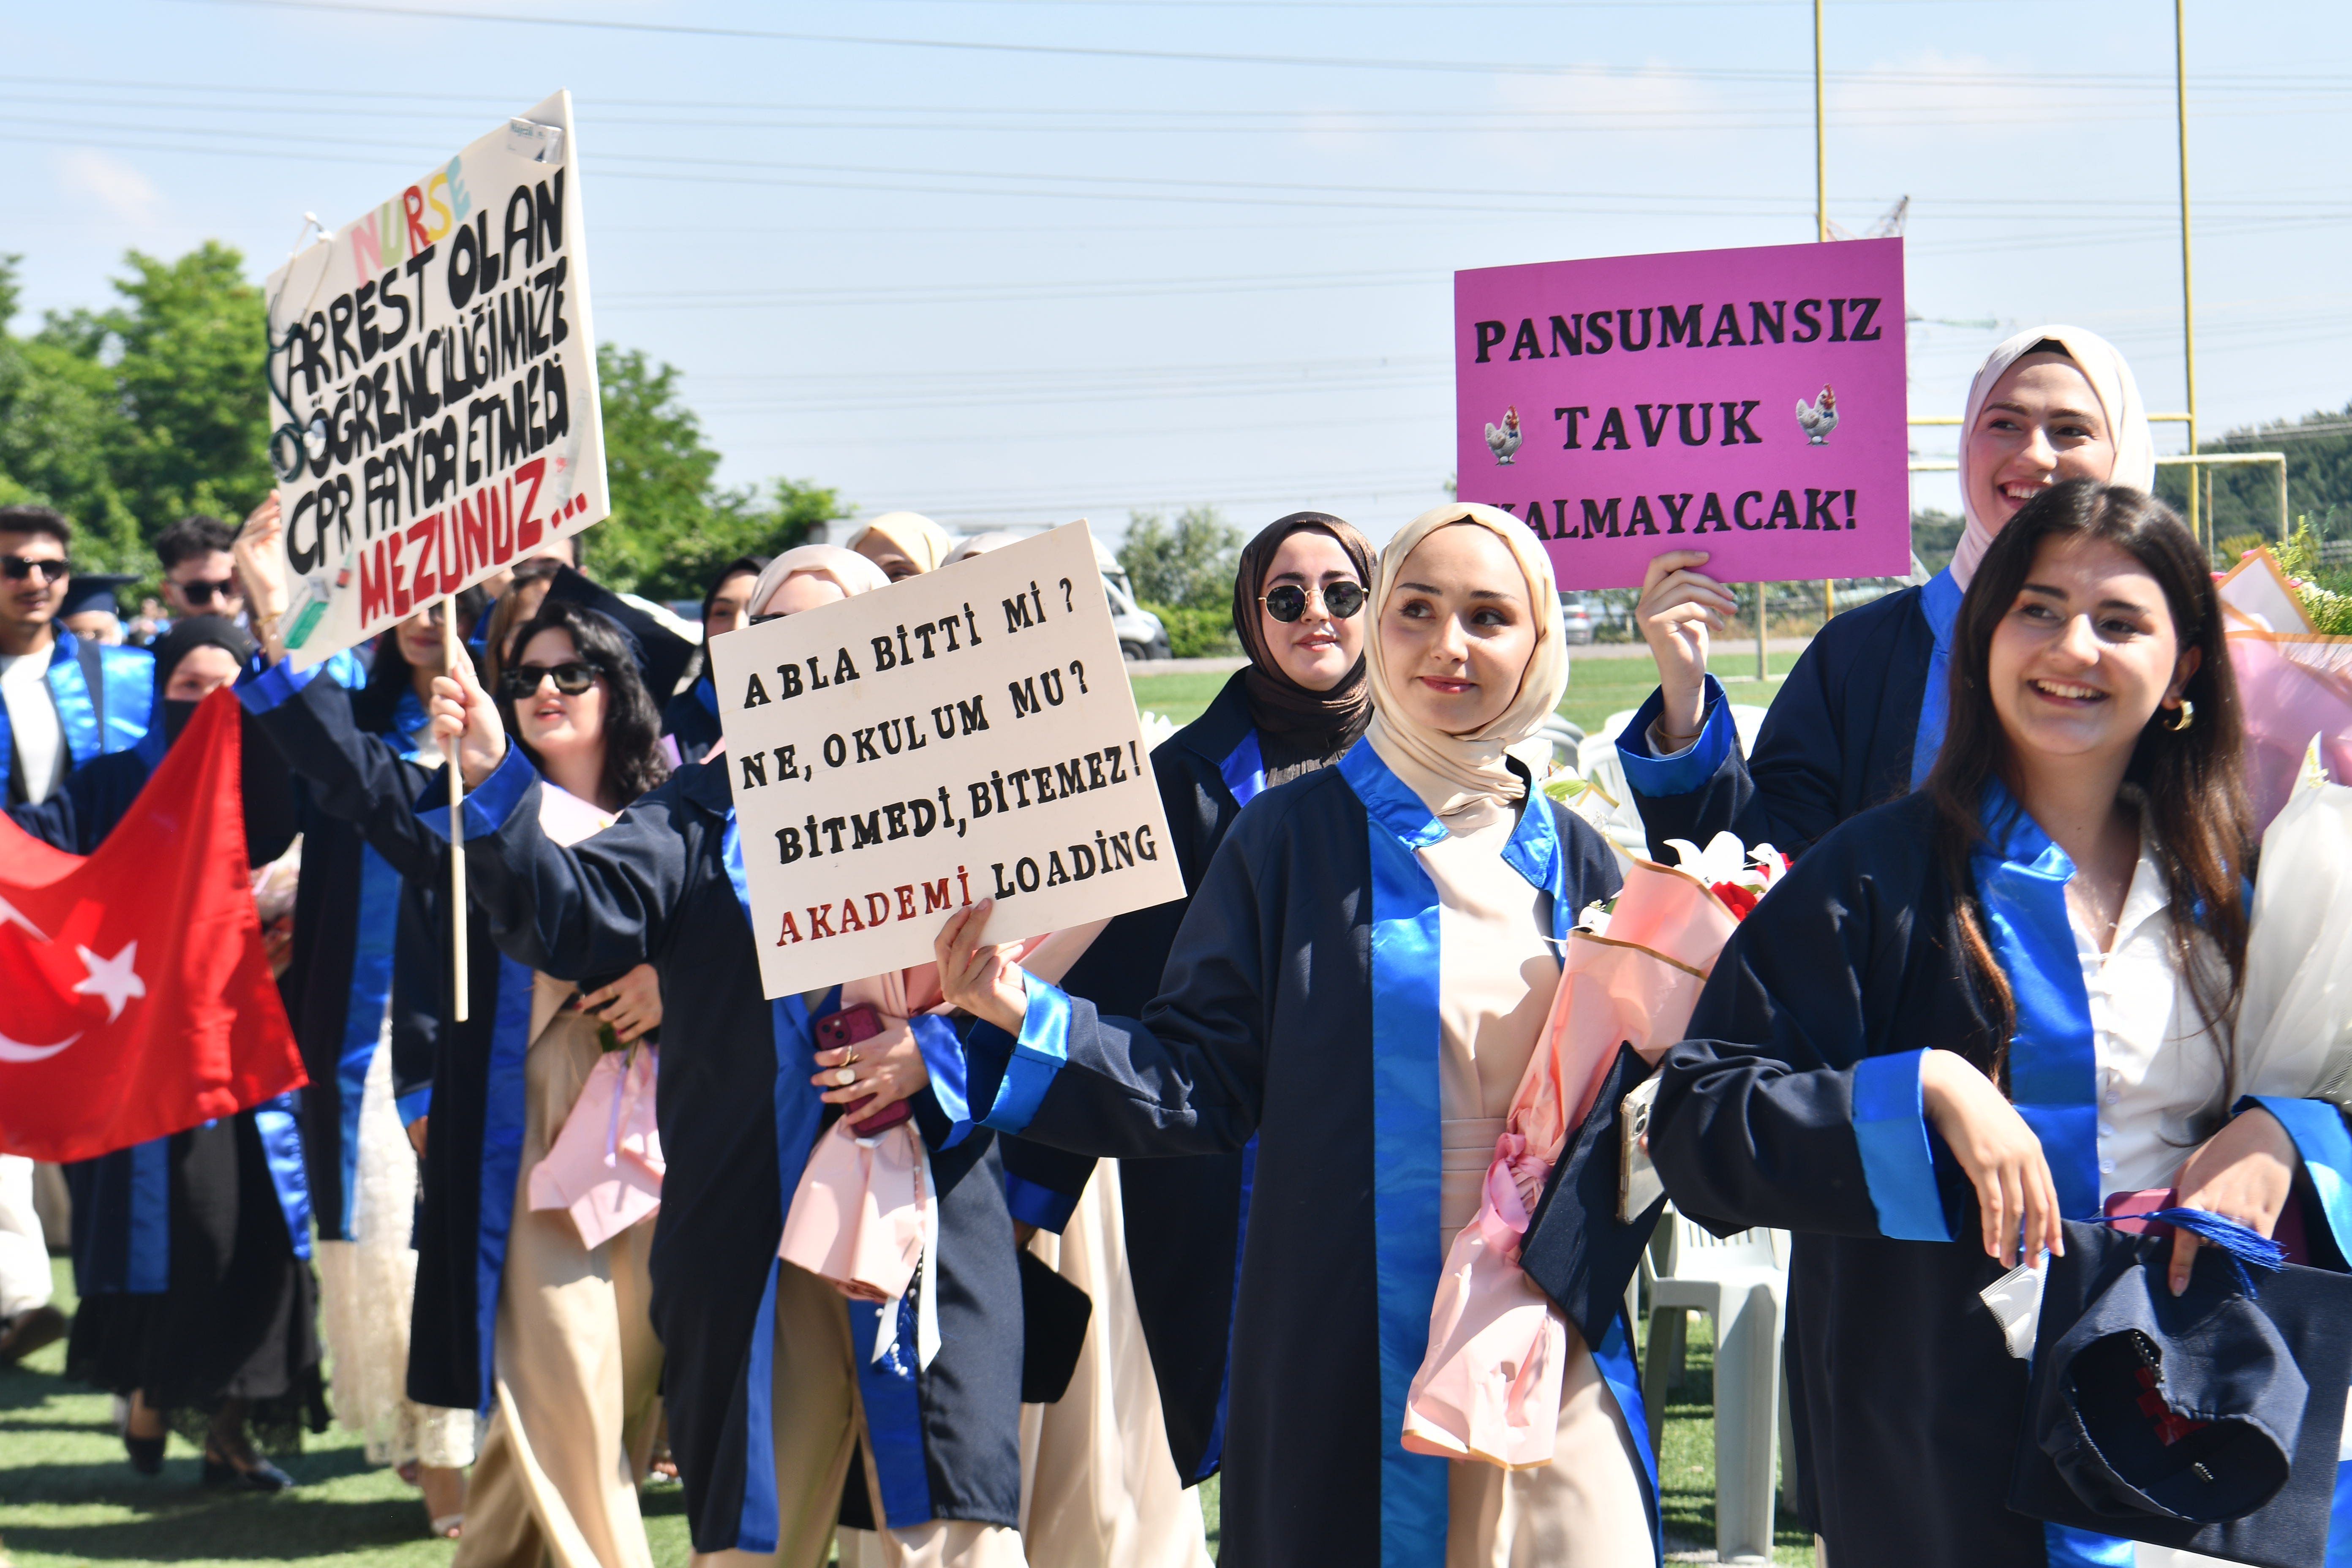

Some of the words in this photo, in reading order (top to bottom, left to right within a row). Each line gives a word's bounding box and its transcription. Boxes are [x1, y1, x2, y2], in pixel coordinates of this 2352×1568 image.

[351, 155, 471, 289] NURSE
[287, 244, 437, 407] ARREST
[448, 167, 564, 310] OLAN
[1474, 298, 1881, 363] PANSUMANSIZ
[1550, 400, 1762, 451] TAVUK
[287, 474, 353, 575] CPR
[364, 414, 457, 539] FAYDA
[1488, 488, 1857, 541] ALMAYACAK!
[744, 647, 860, 709] ABLA
[871, 602, 982, 672] BİTTİ
[1002, 580, 1046, 634] Mİ
[776, 865, 972, 946] AKADEMİ
[991, 825, 1157, 901] LOADİNG
